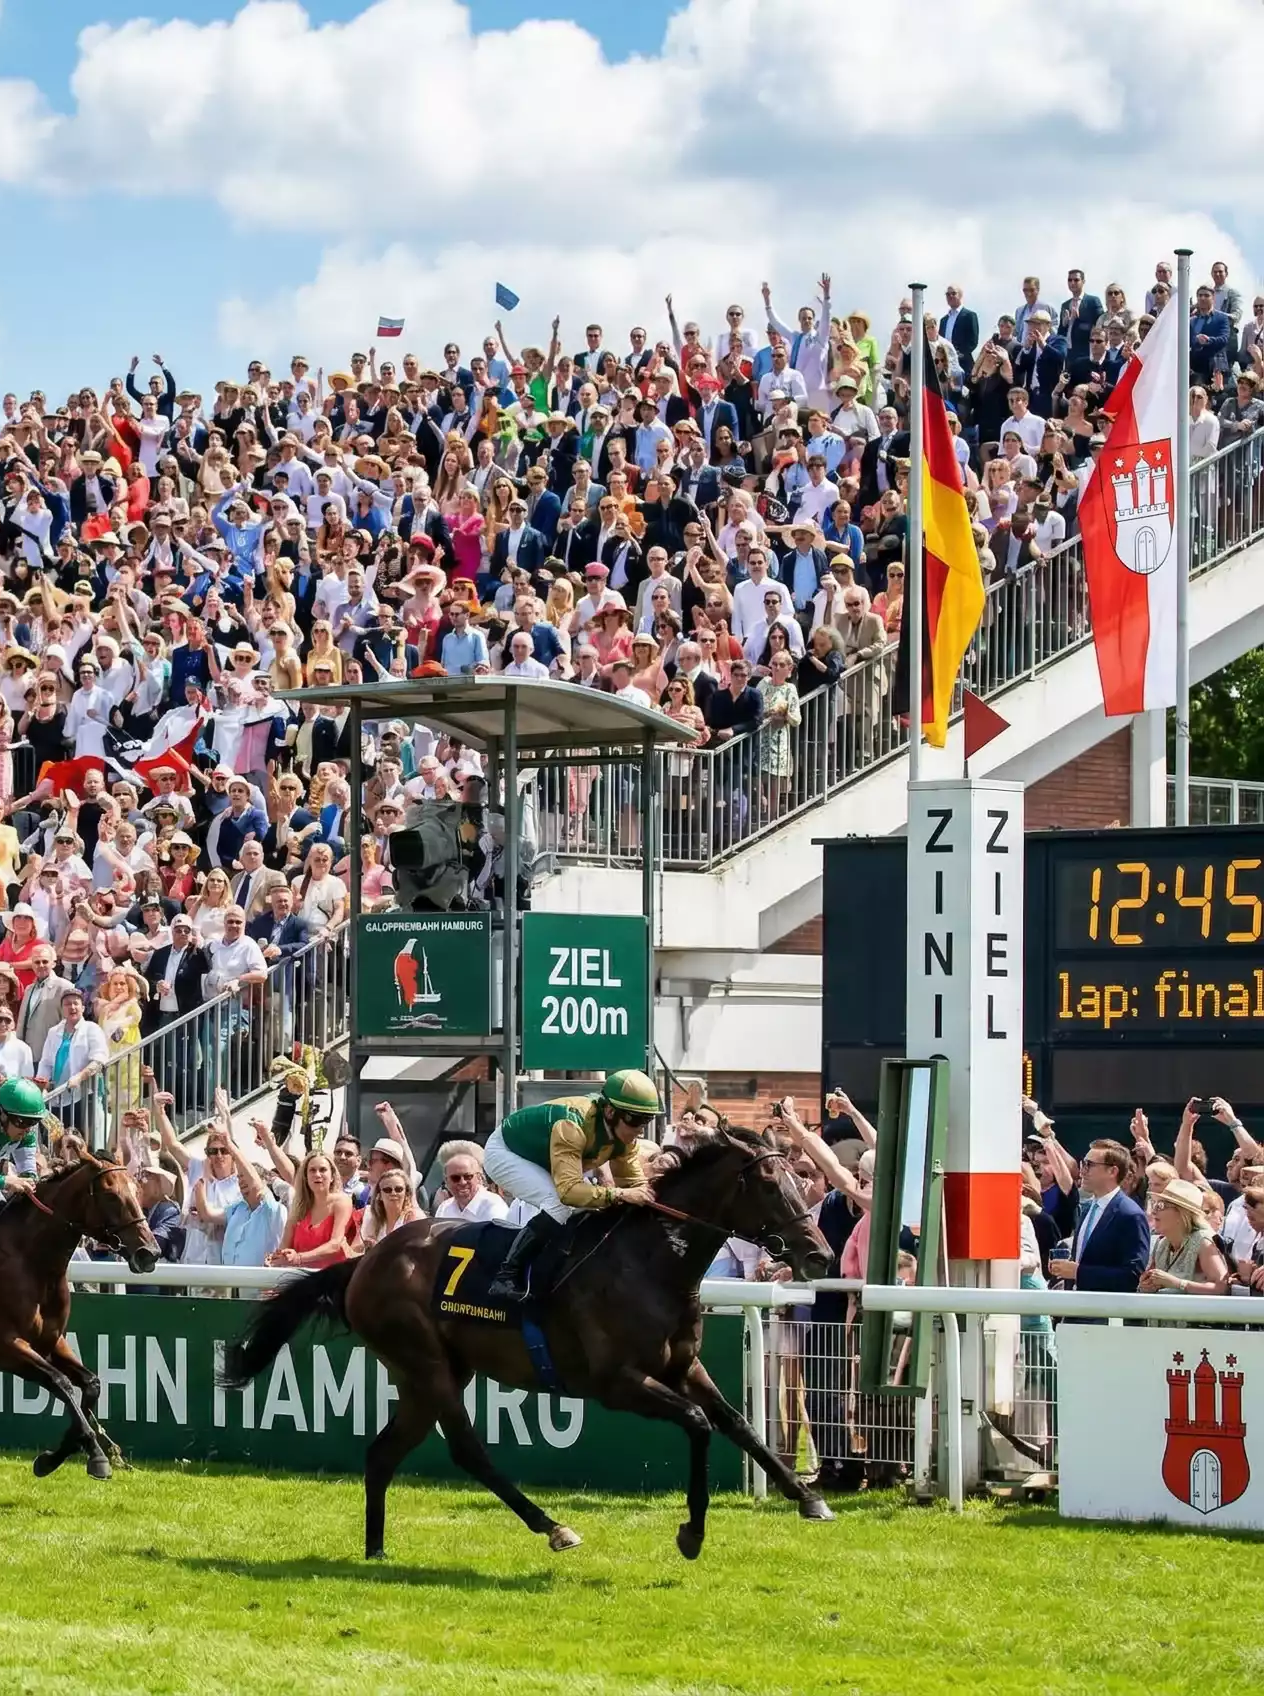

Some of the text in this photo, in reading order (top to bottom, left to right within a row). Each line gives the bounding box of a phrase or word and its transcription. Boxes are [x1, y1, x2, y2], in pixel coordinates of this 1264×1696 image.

[441, 920, 484, 932] HAMBURG
[986, 809, 1009, 1040] ZIEL
[1089, 859, 1263, 945] 12:45
[924, 808, 954, 1060] ZINI
[548, 947, 622, 987] ZIEL
[541, 995, 628, 1036] 200m
[1059, 970, 1264, 1029] lap: final
[443, 1245, 475, 1296] 7
